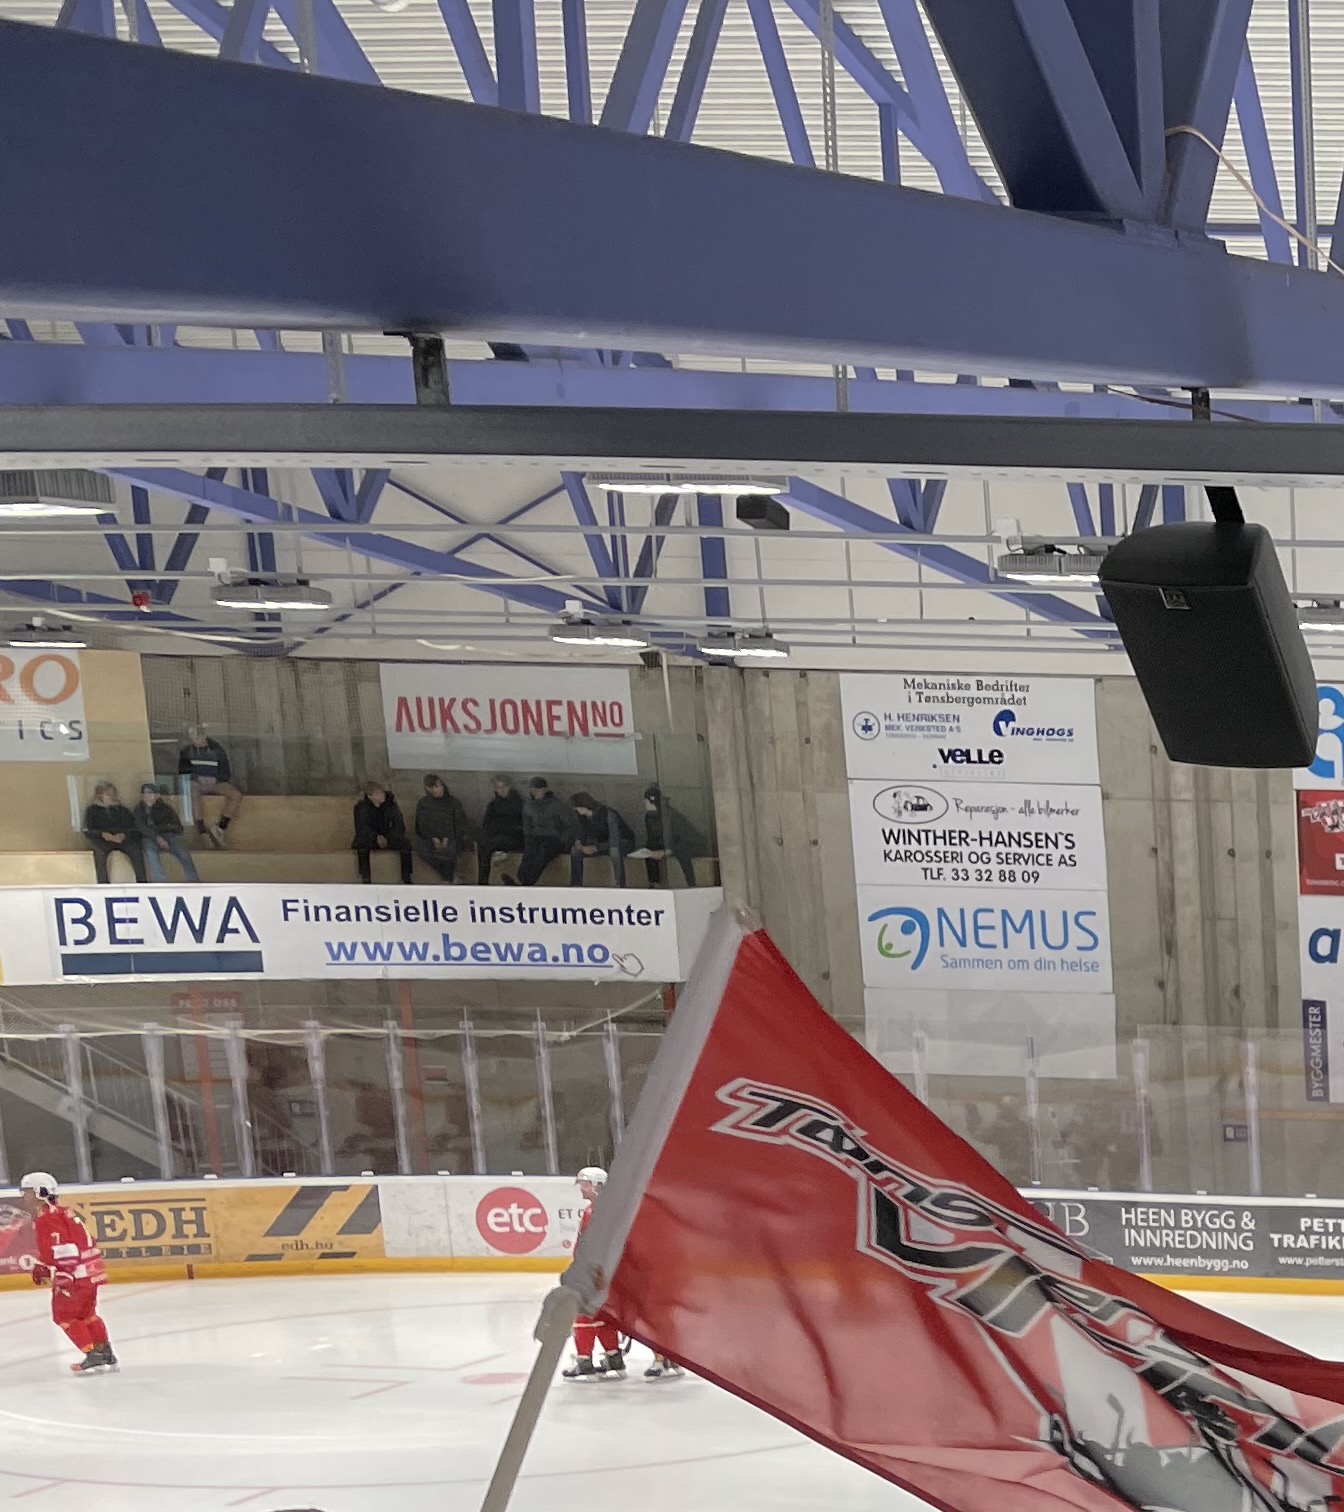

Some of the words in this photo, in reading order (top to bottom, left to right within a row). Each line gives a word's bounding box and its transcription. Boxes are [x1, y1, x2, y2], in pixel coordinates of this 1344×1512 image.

[903, 678, 971, 692] Mekaniske
[976, 680, 1030, 693] Bedrifter
[915, 692, 1027, 707] Tønsbergområdet
[897, 713, 960, 723] HENRIKSEN
[883, 850, 963, 865] KAROSSERI
[968, 851, 992, 865] OG
[996, 852, 1054, 867] SERVICE
[1058, 854, 1077, 868] AS
[921, 867, 947, 882] TLF.
[951, 868, 970, 881] 33
[975, 869, 993, 882] 32
[998, 869, 1017, 883] 88
[1022, 870, 1040, 884] 09
[54, 896, 261, 945] BEWA
[281, 899, 459, 926] Finansielle
[468, 901, 665, 928] instrumenter
[936, 906, 1099, 952] NEMUS
[325, 934, 611, 964] www.bewa.no
[940, 954, 1002, 970] Sammen
[1007, 957, 1029, 970] om
[1034, 955, 1056, 971] din
[1060, 956, 1100, 973] helse
[1308, 1006, 1325, 1097] BYGGMESTER
[78, 1203, 210, 1242] EDH
[1121, 1207, 1178, 1227] HEEN
[1182, 1210, 1236, 1230] BYGG
[1241, 1211, 1256, 1230] &
[1124, 1228, 1254, 1251] INNREDNING
[1131, 1255, 1249, 1271] www.heenbygg.no
